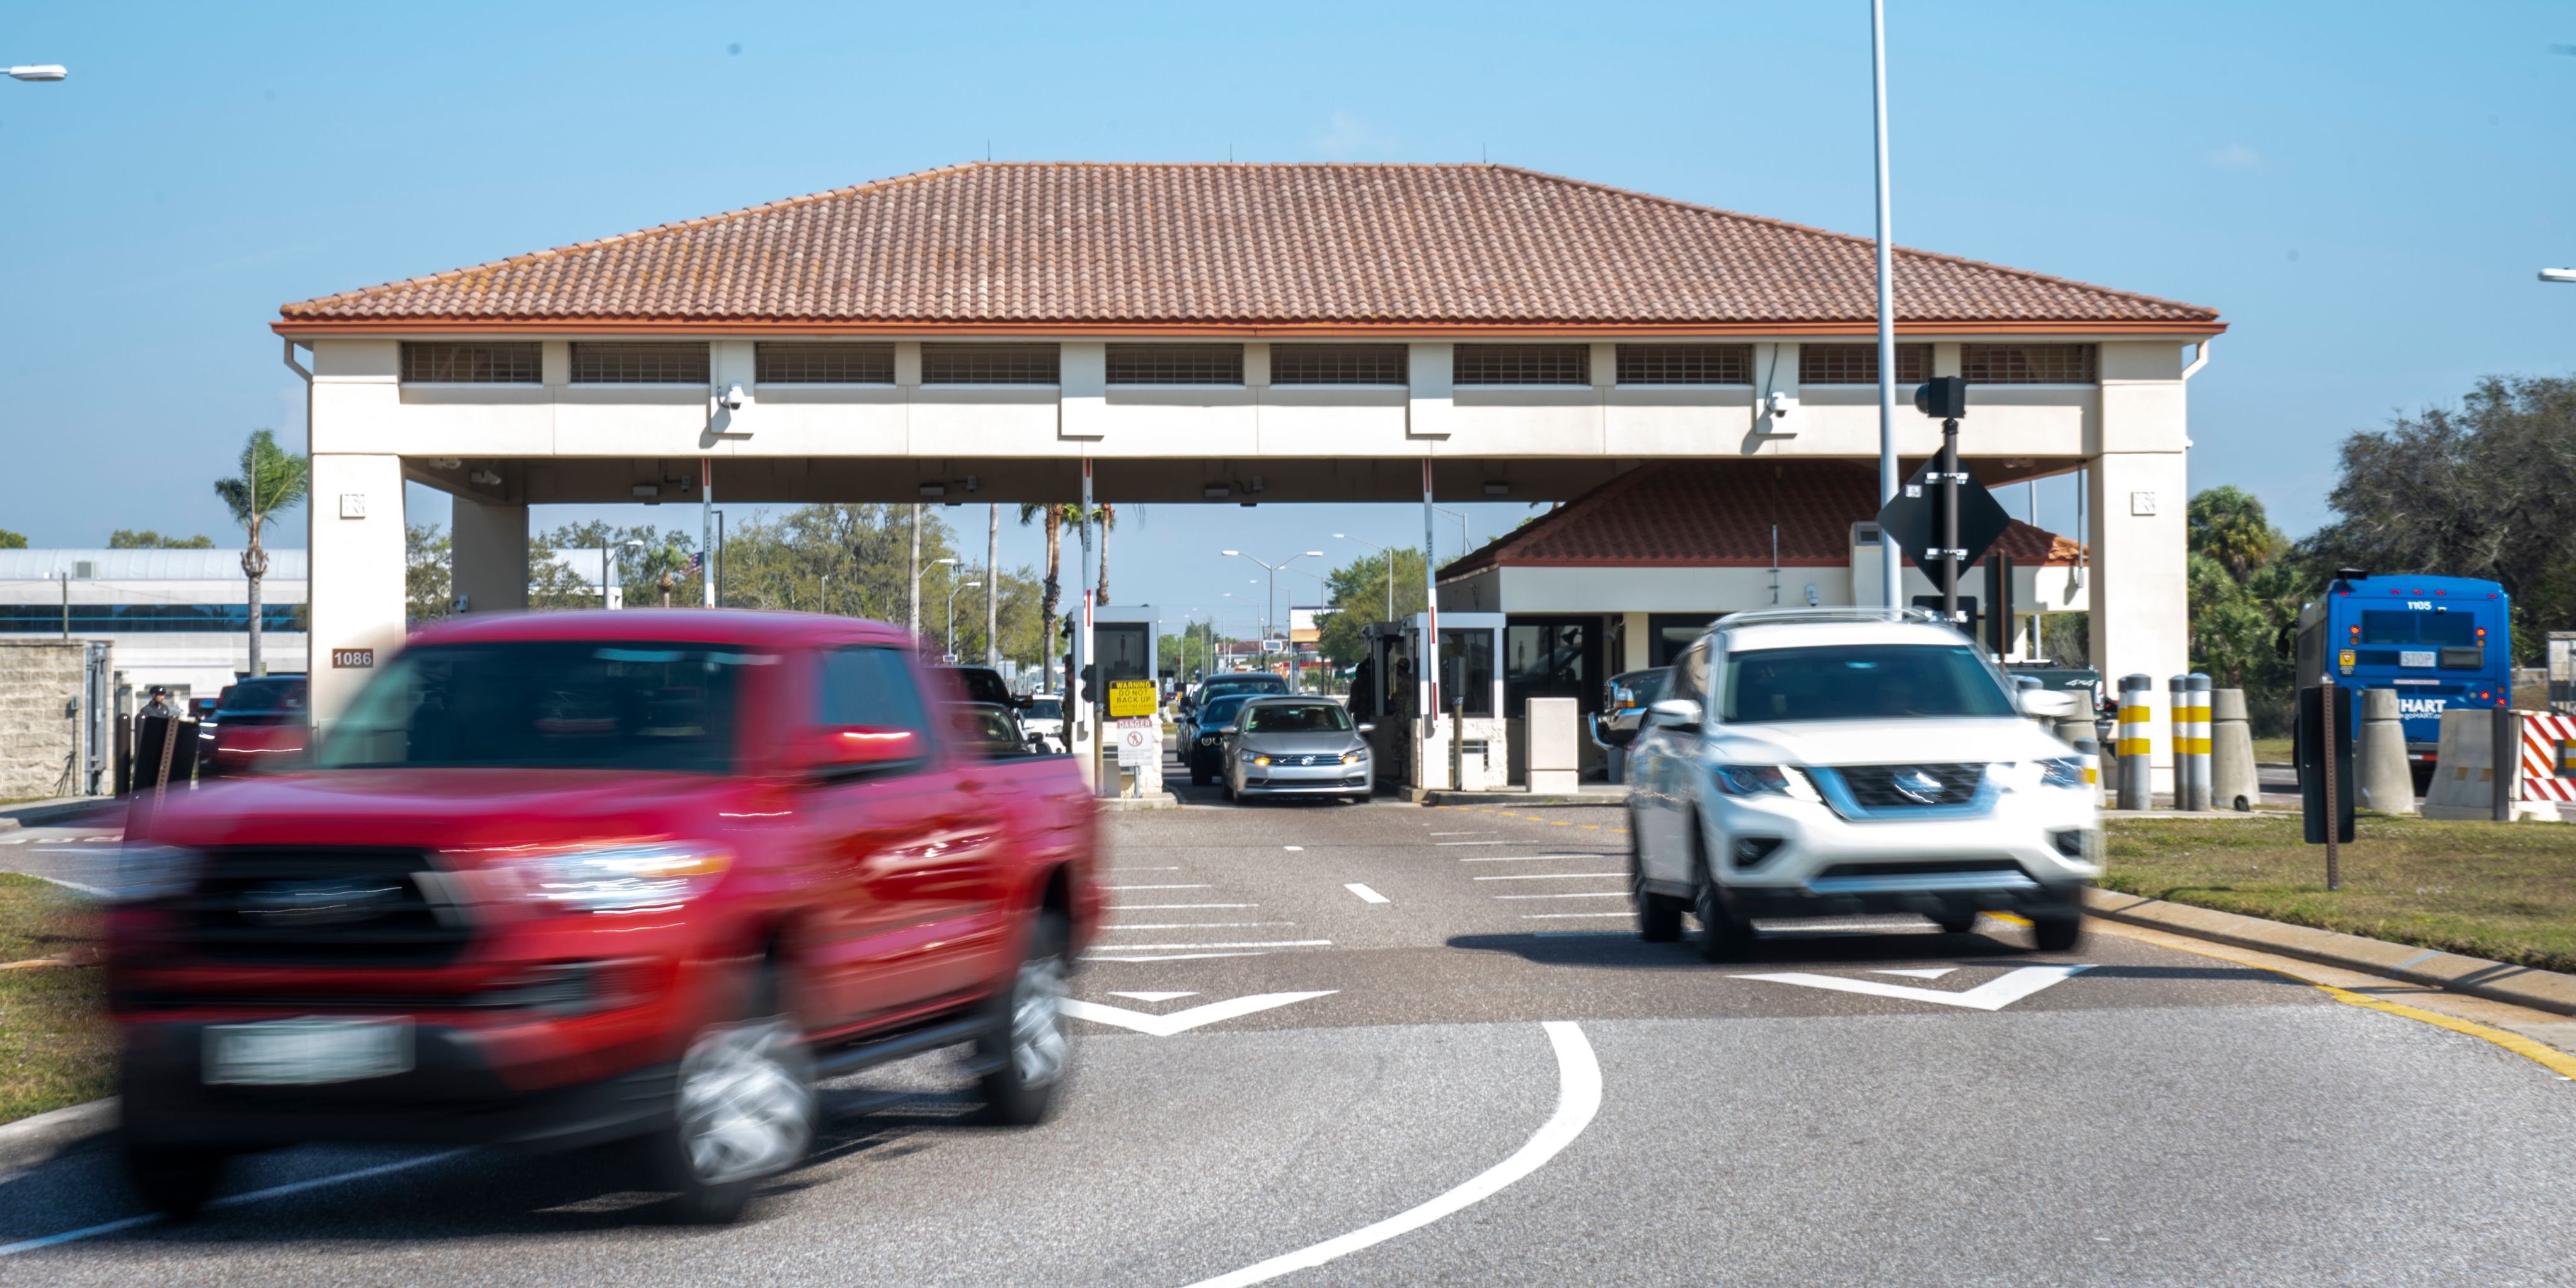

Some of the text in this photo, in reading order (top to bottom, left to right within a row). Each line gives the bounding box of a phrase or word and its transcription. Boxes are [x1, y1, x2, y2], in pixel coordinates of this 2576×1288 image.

[2407, 601, 2432, 610] 1105
[334, 652, 372, 665] 1086
[2402, 653, 2432, 665] STOP
[1118, 720, 1150, 728] DANGER
